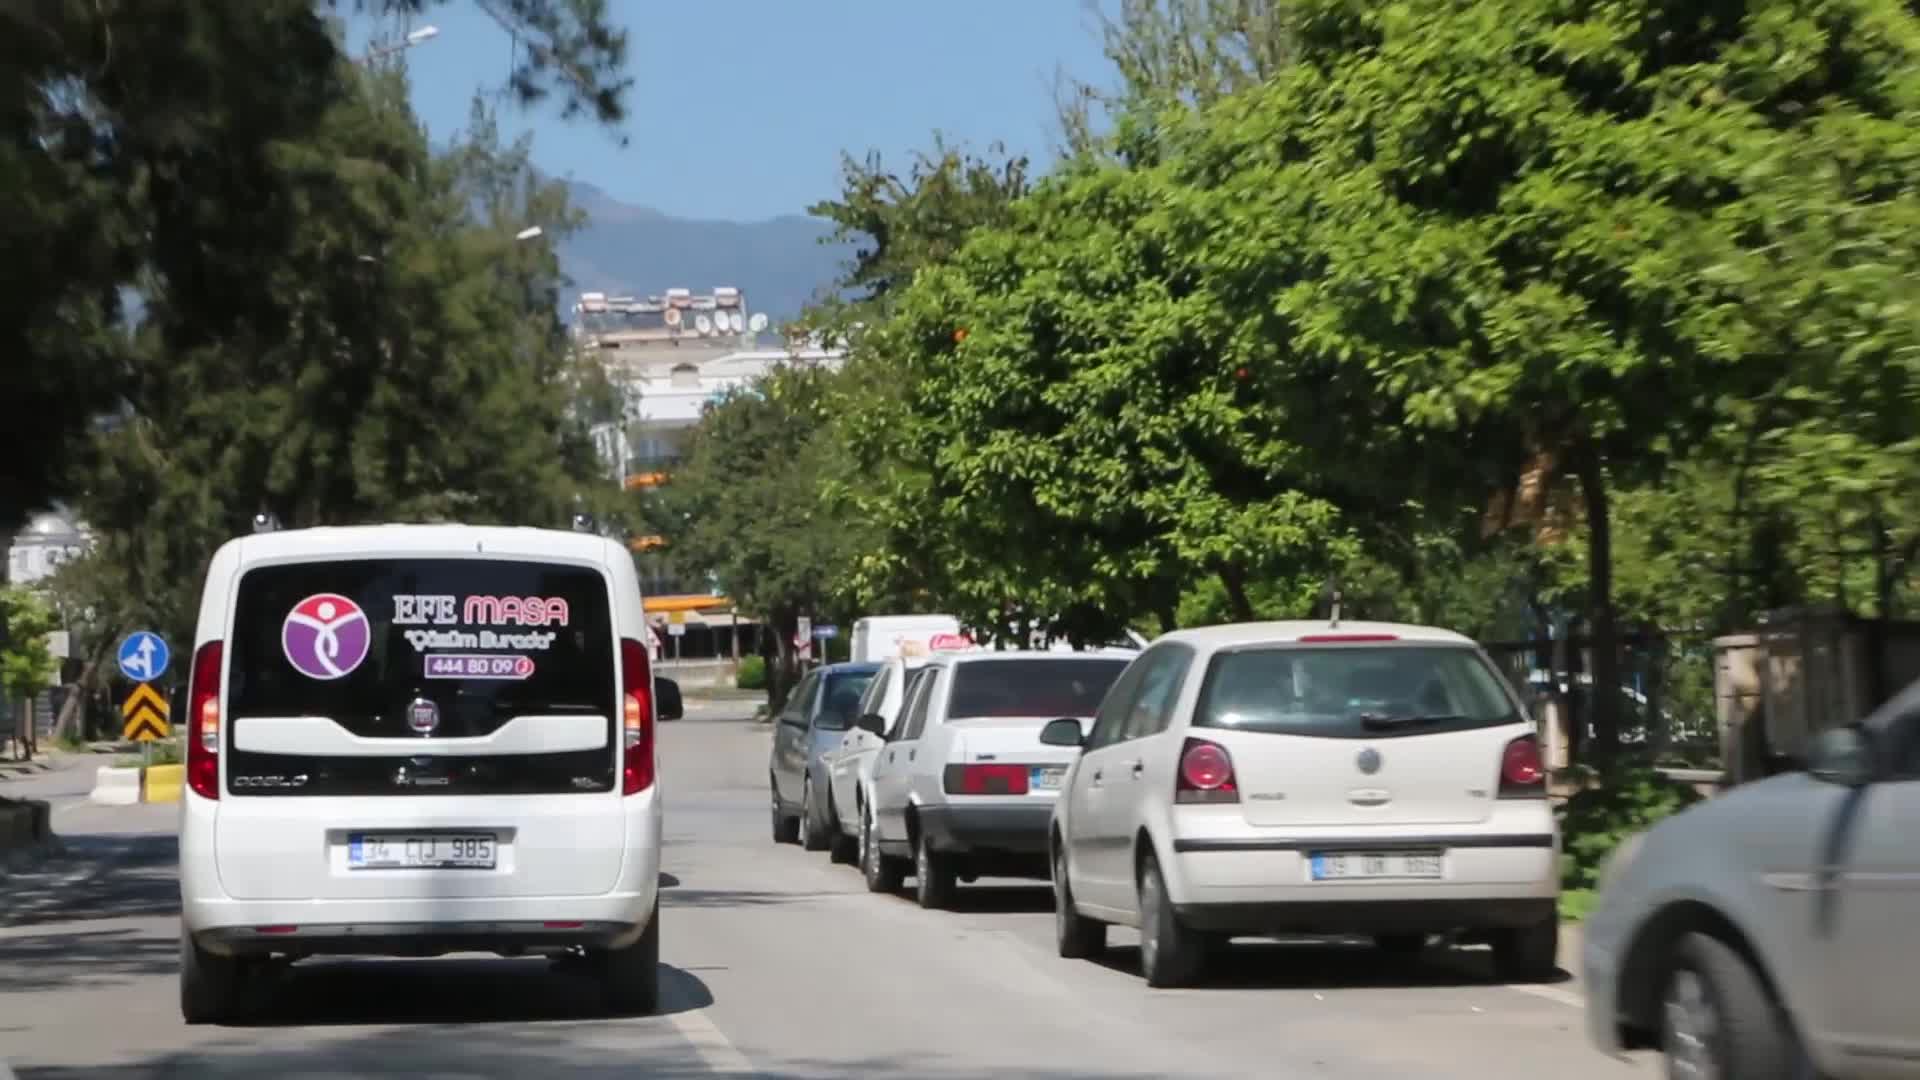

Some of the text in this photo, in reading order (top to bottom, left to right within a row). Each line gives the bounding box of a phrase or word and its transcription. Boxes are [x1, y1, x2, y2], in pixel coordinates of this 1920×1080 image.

[392, 595, 569, 626] EFE MASA
[432, 658, 514, 674] 444 80 09
[452, 838, 491, 859] 985
